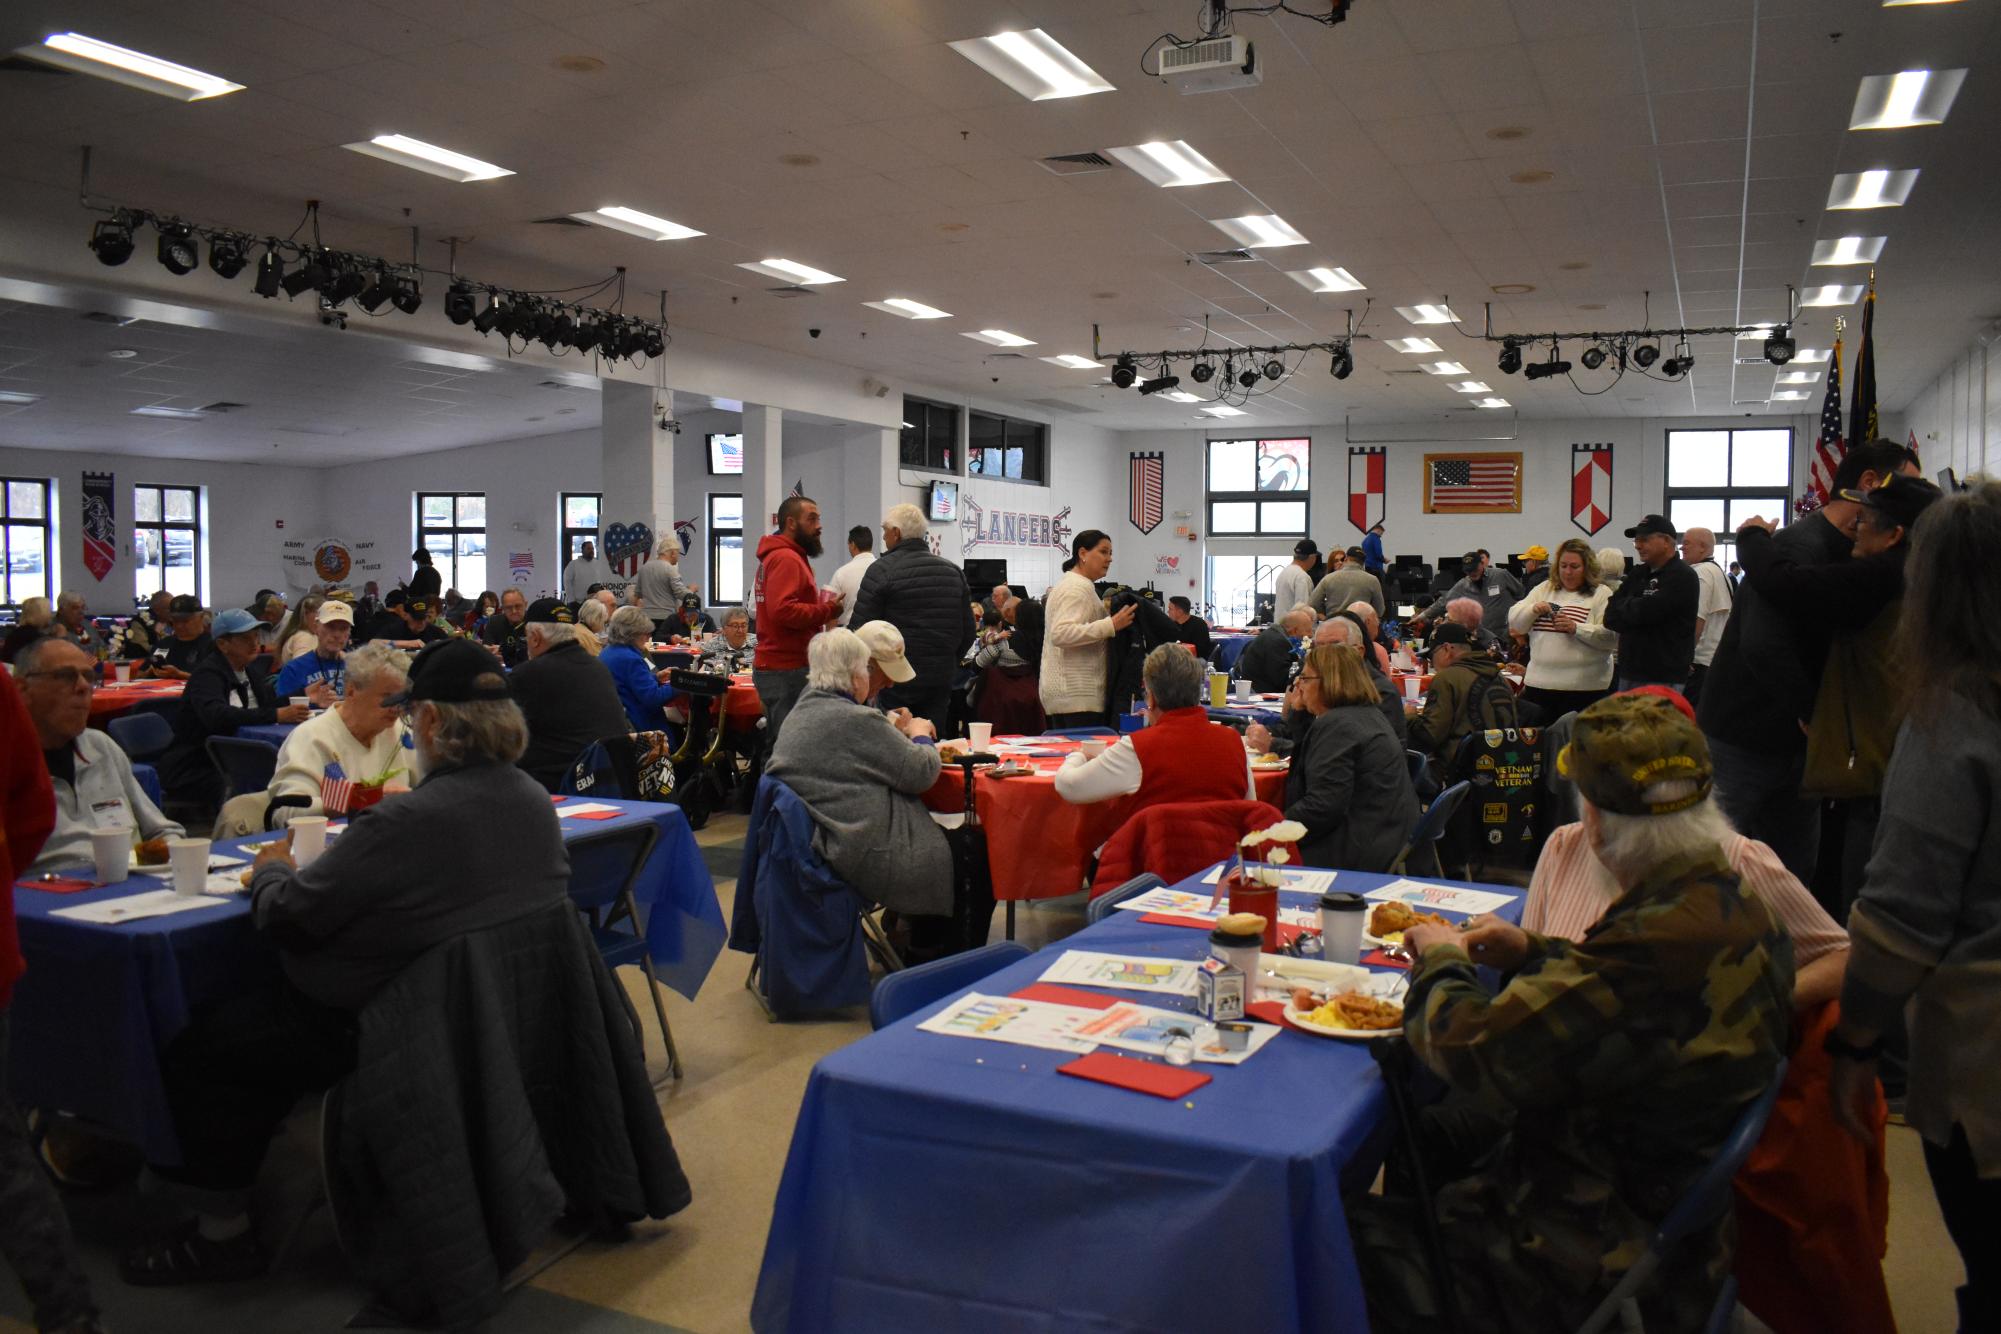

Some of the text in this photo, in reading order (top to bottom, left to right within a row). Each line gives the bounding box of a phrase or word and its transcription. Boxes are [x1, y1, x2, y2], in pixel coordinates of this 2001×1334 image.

[974, 509, 1062, 548] LANCERS
[284, 541, 305, 549] ARMY
[282, 554, 306, 562] MARINE
[362, 563, 382, 571] FORCE
[1495, 765, 1533, 774] VIETNAM
[1495, 778, 1533, 788] VETERAN
